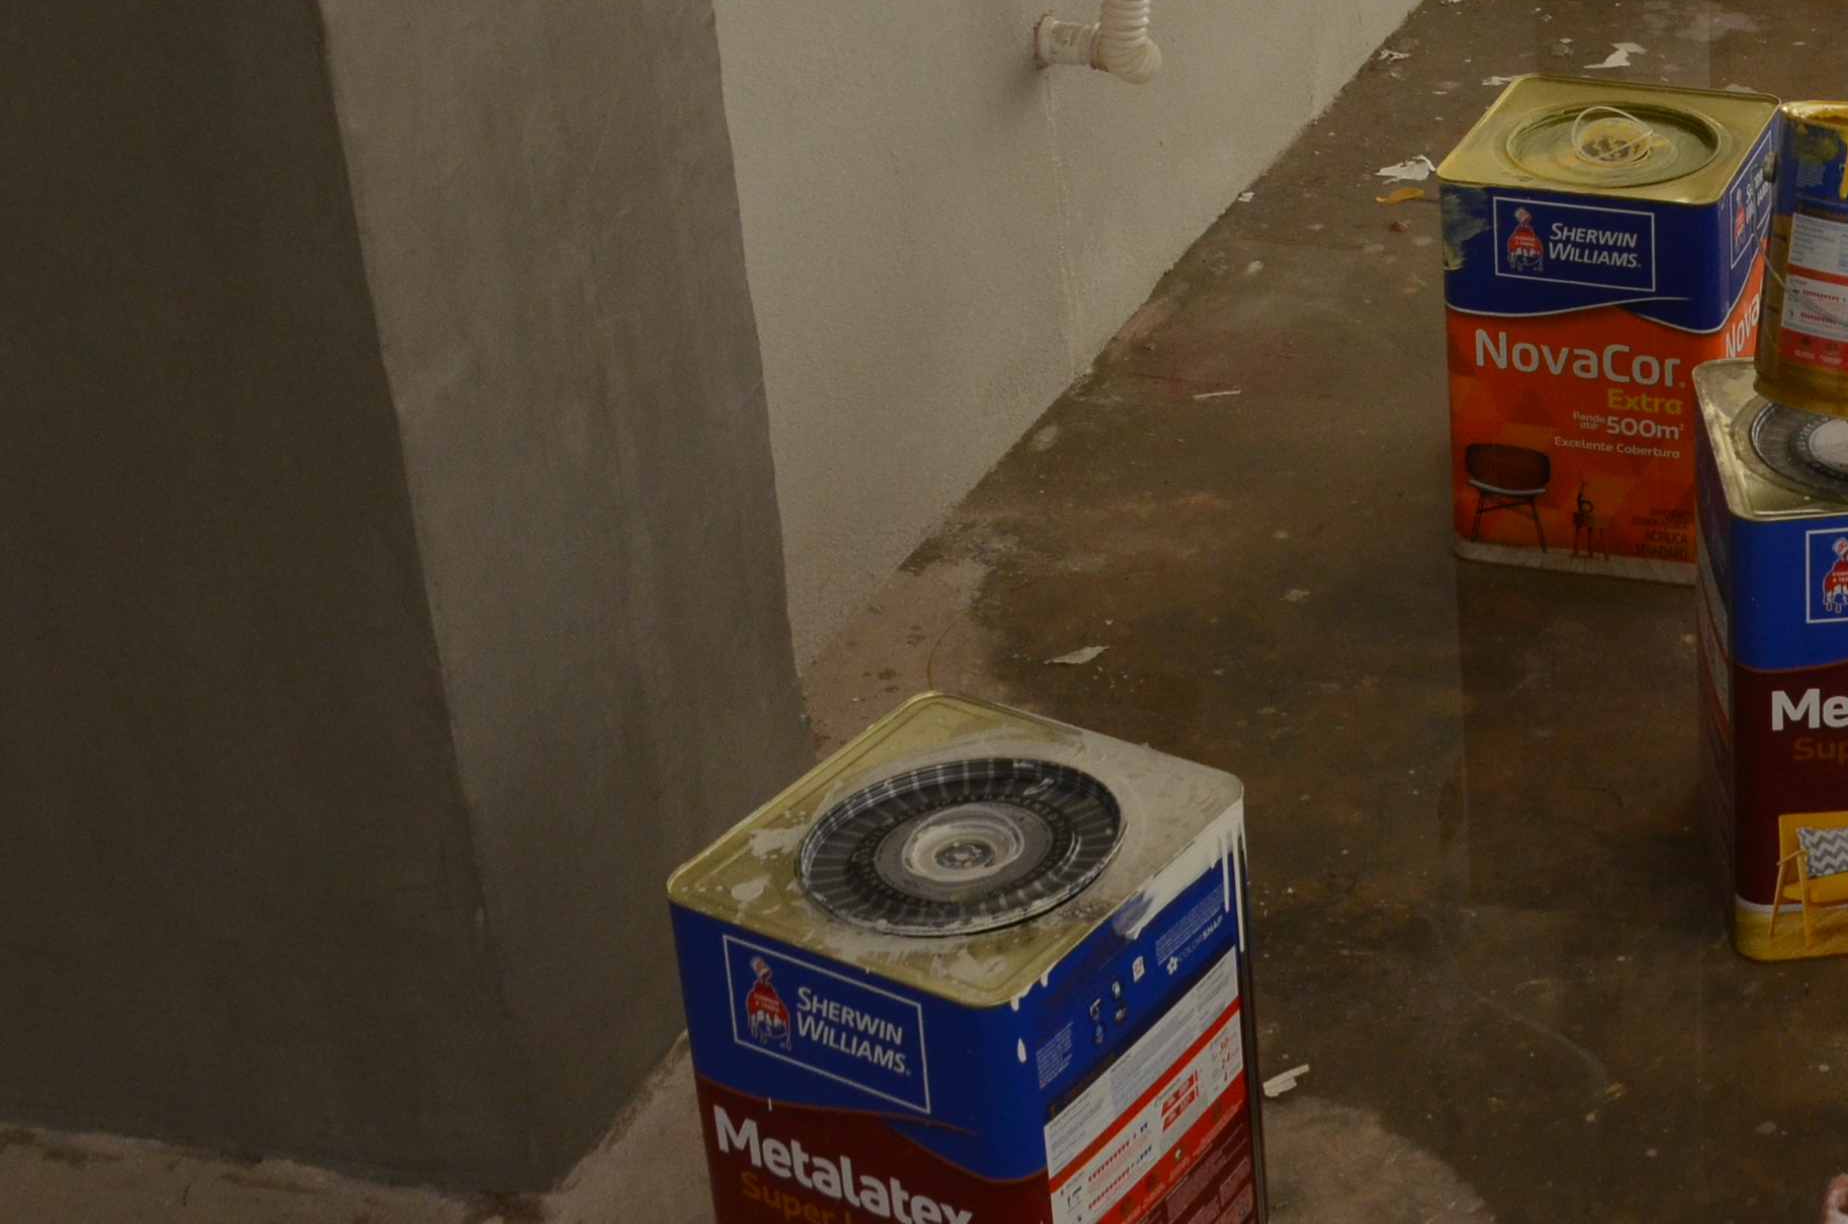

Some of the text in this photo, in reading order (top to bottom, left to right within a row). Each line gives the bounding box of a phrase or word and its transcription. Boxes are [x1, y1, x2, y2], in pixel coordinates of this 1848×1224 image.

[1550, 222, 1637, 248] SHERWIN
[1548, 242, 1638, 268] WILLIAMS
[1475, 328, 1681, 387] NovaCor
[1607, 388, 1683, 415] Extra
[1573, 411, 1606, 424] Rende
[1554, 436, 1680, 458] Excelente Cobertura
[1635, 543, 1688, 561] STANDARD
[796, 986, 903, 1046] SHERWIN
[796, 1011, 906, 1075] WILLIAMS
[713, 1104, 973, 1224] Metalatex
